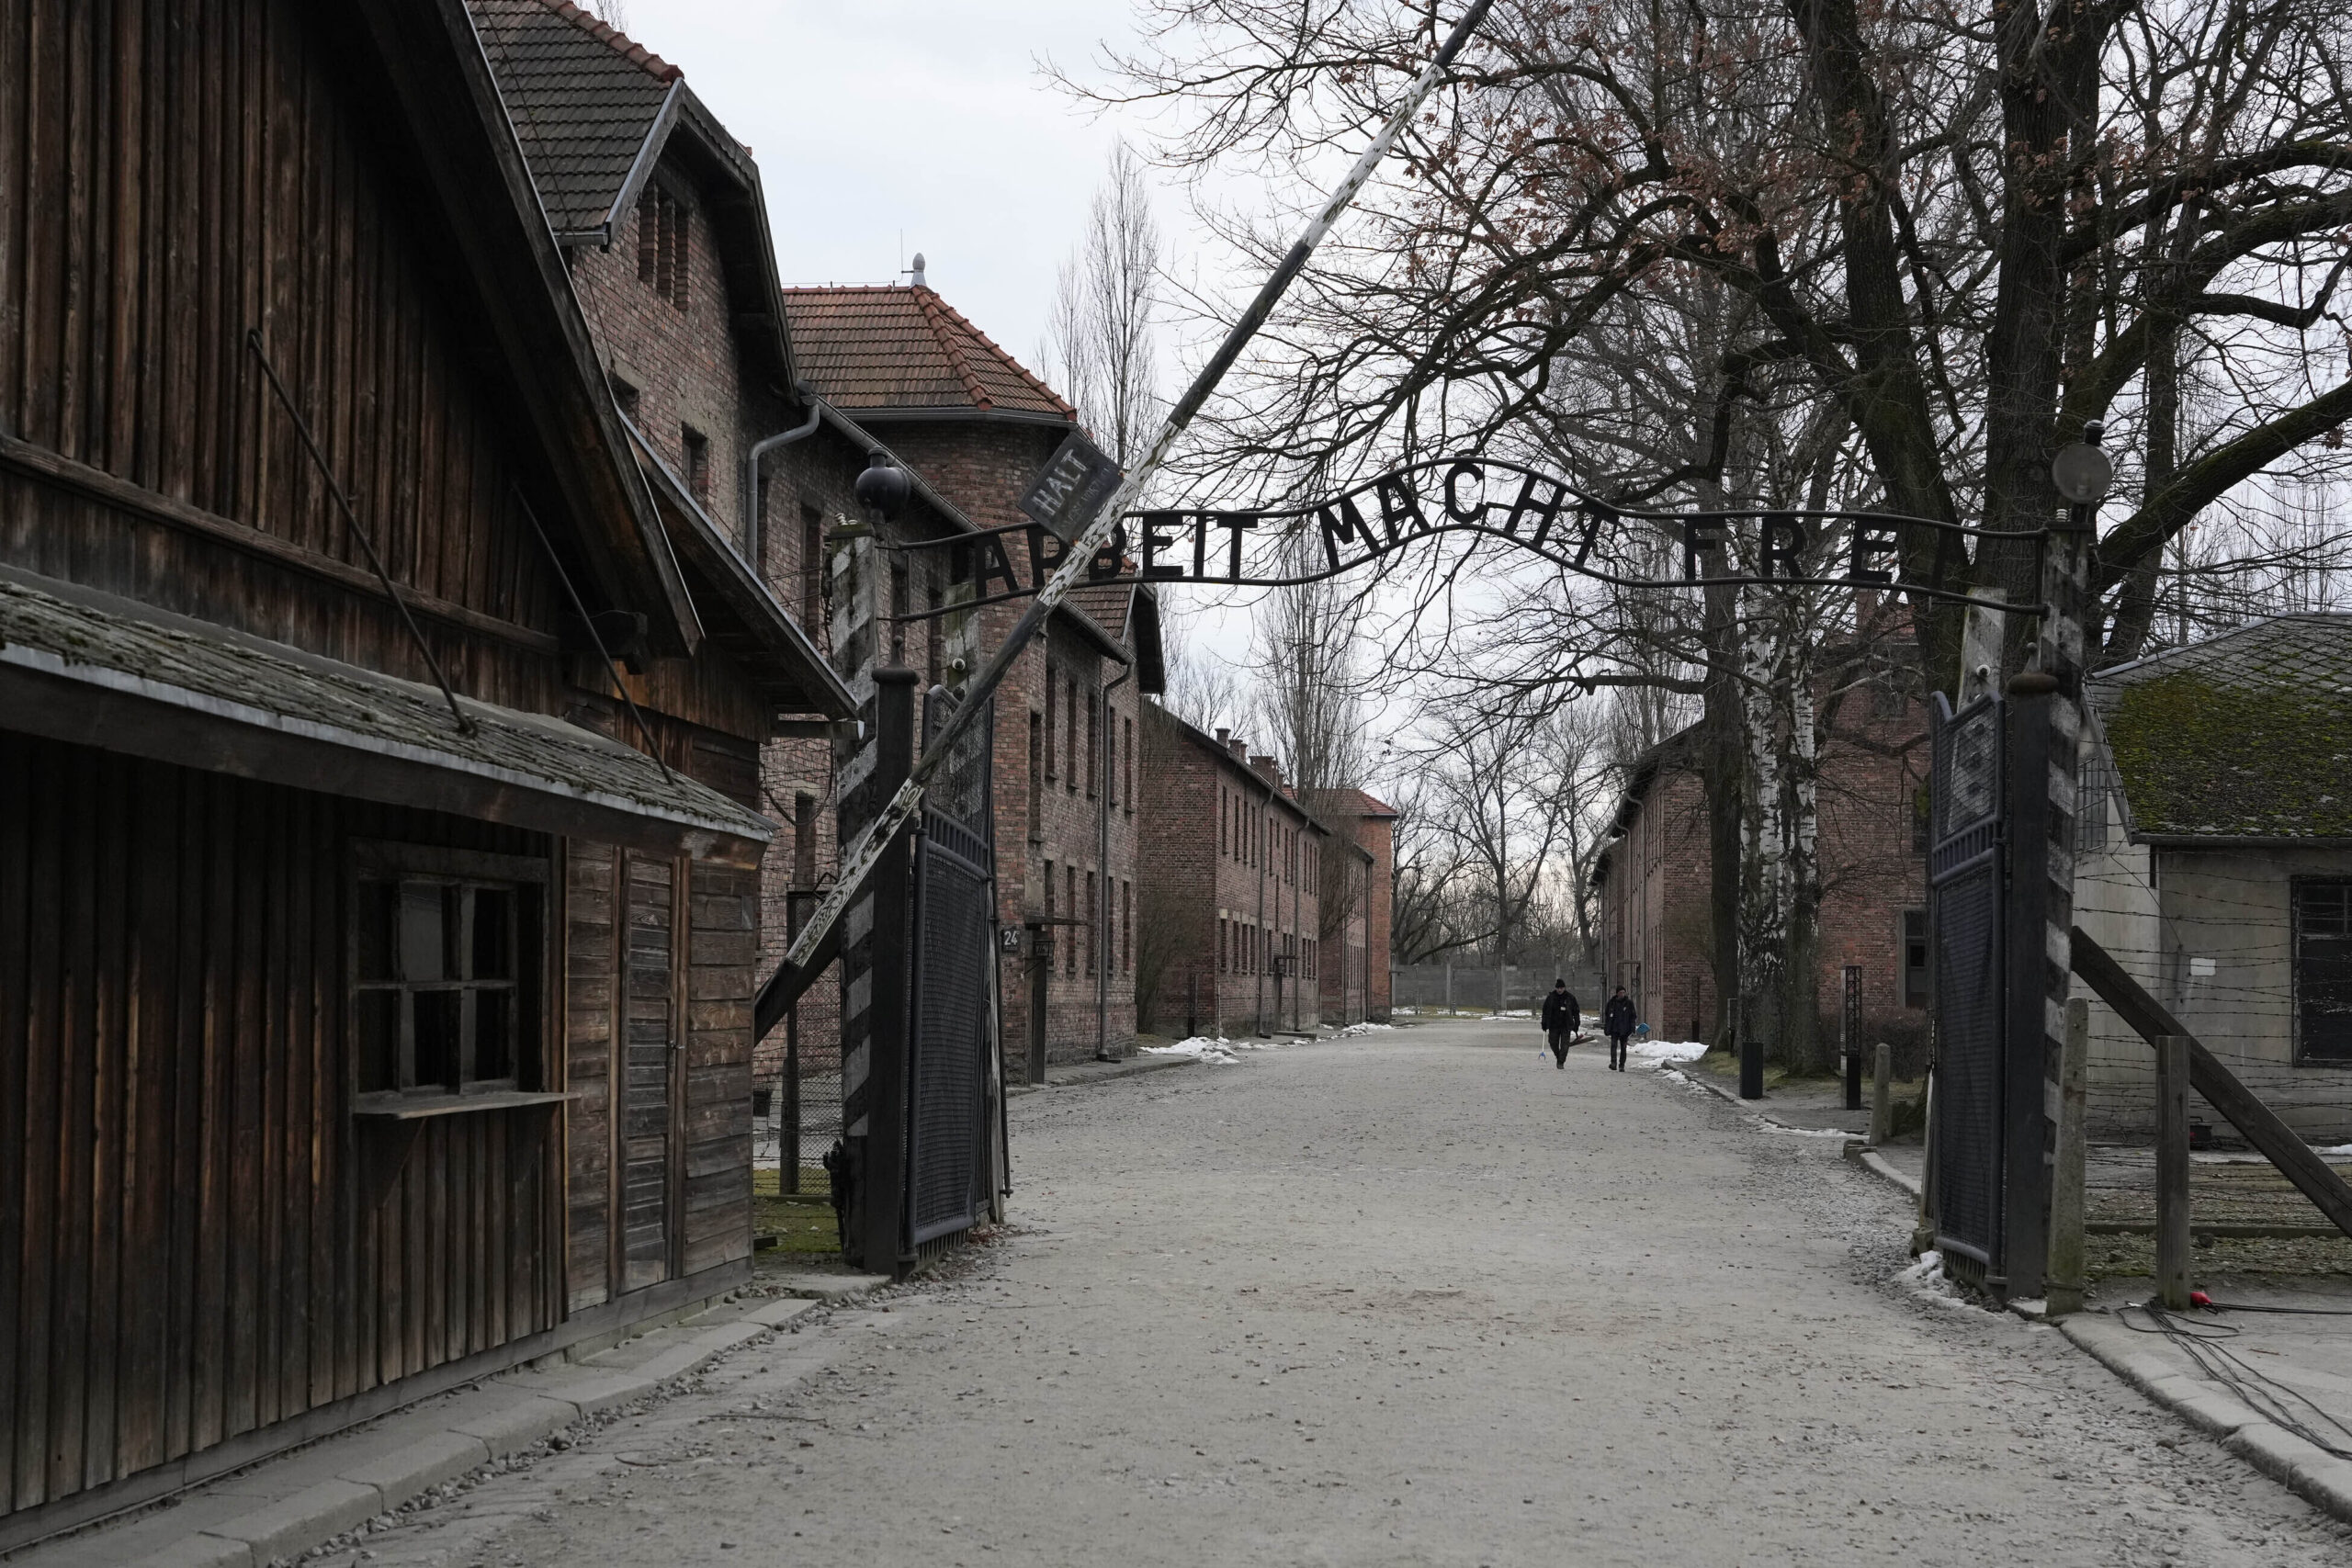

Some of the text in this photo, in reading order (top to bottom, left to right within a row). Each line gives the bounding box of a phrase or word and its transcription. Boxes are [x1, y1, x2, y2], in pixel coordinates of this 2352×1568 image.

[1031, 449, 1088, 517] HALT
[1317, 463, 1620, 570] MACHT
[1004, 931, 1018, 945] 24
